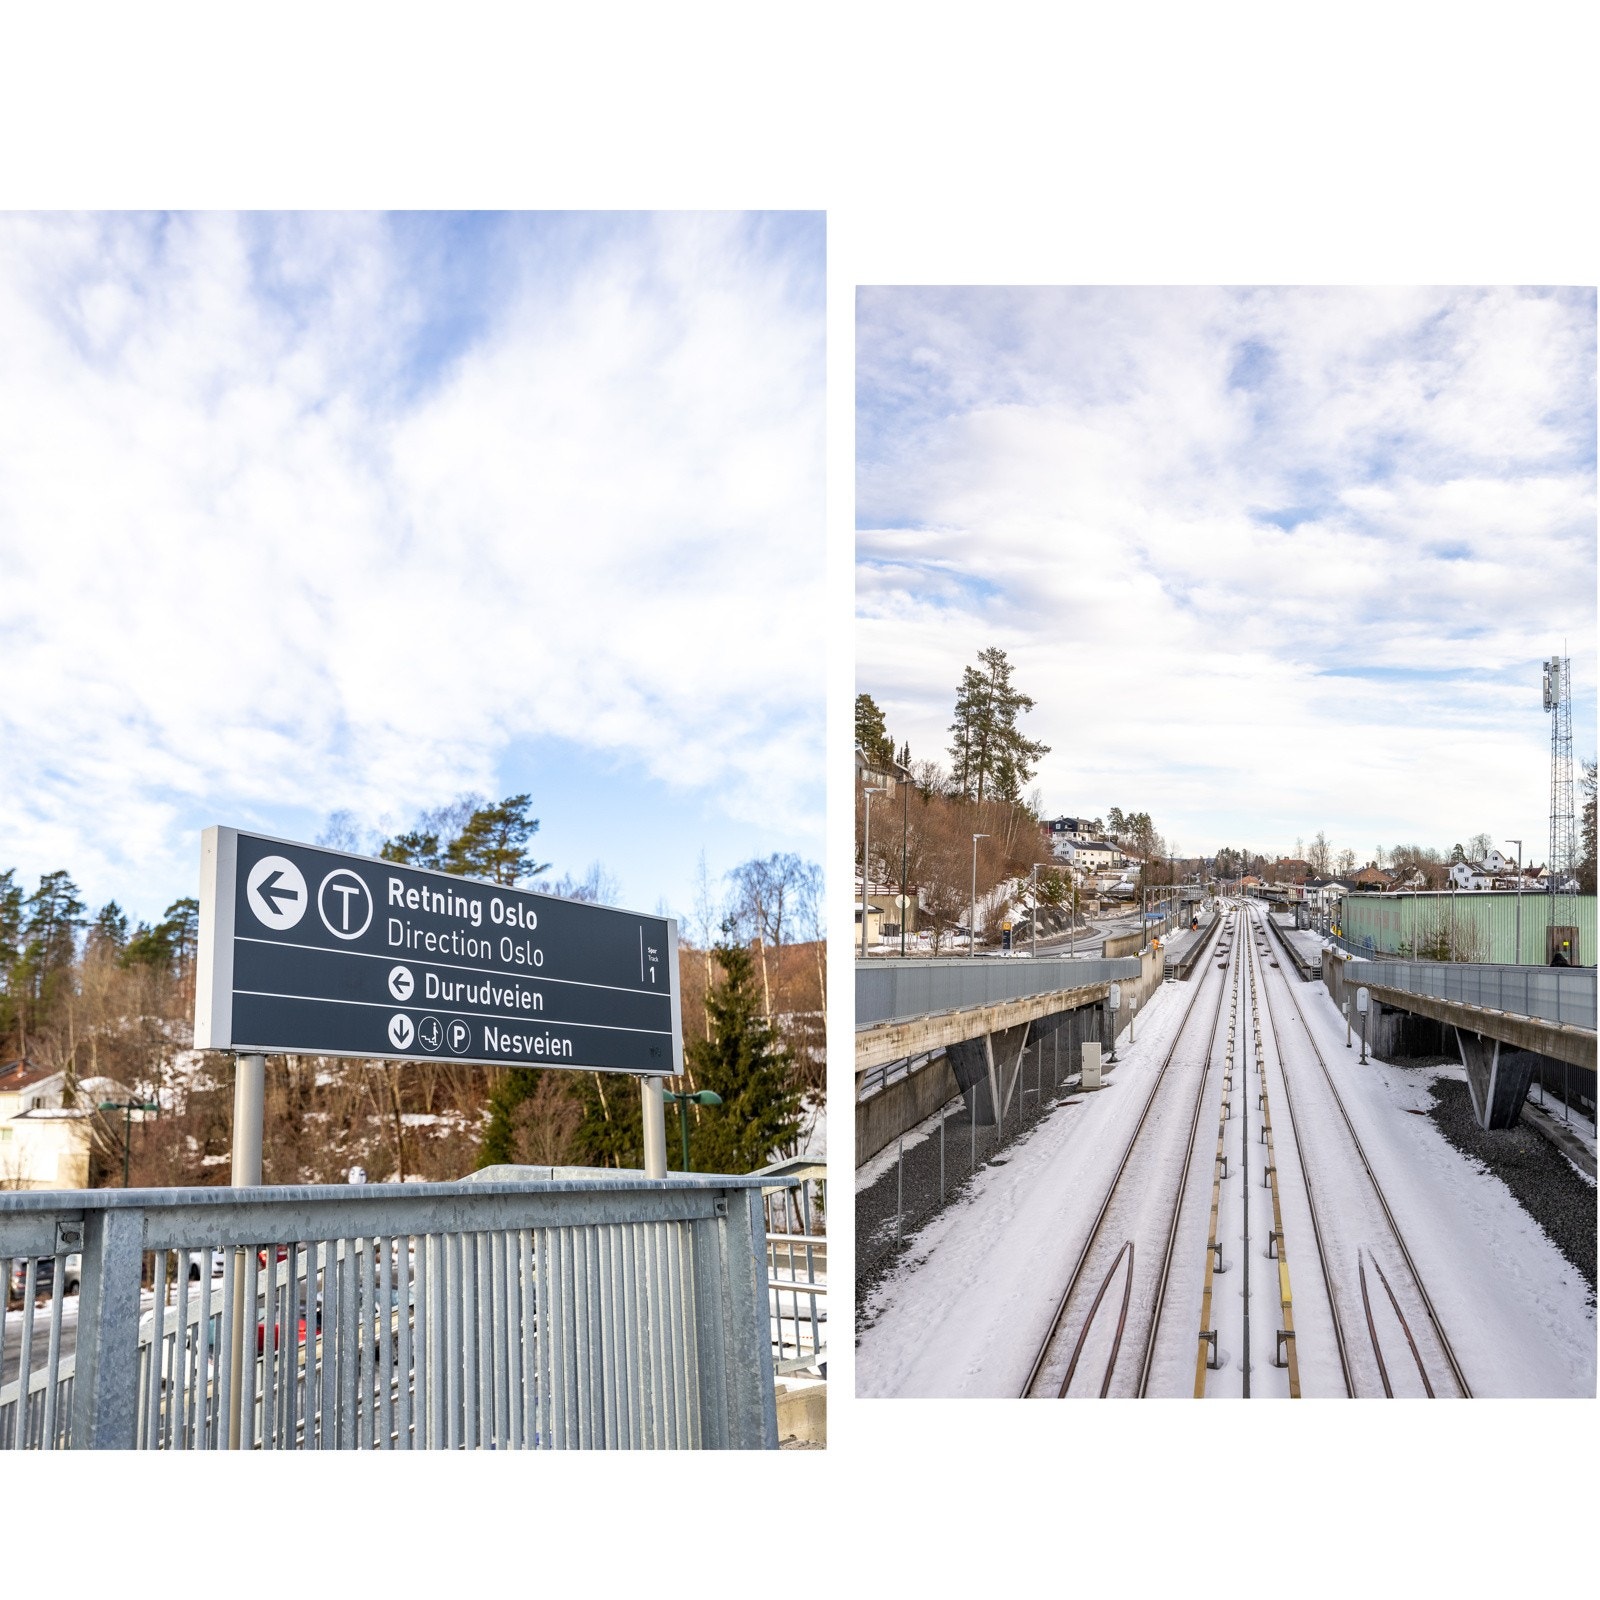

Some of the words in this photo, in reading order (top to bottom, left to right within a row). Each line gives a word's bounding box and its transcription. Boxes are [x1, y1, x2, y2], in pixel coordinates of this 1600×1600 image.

[332, 883, 360, 931] T
[388, 876, 483, 928] Retning
[490, 897, 538, 931] Oslo
[388, 917, 492, 960] Direction
[499, 936, 544, 967] Oslo
[647, 946, 658, 955] Spor
[647, 954, 659, 963] Track
[425, 972, 544, 1011] Durudveien
[649, 966, 656, 984] 1
[484, 1025, 573, 1057] Nesveien
